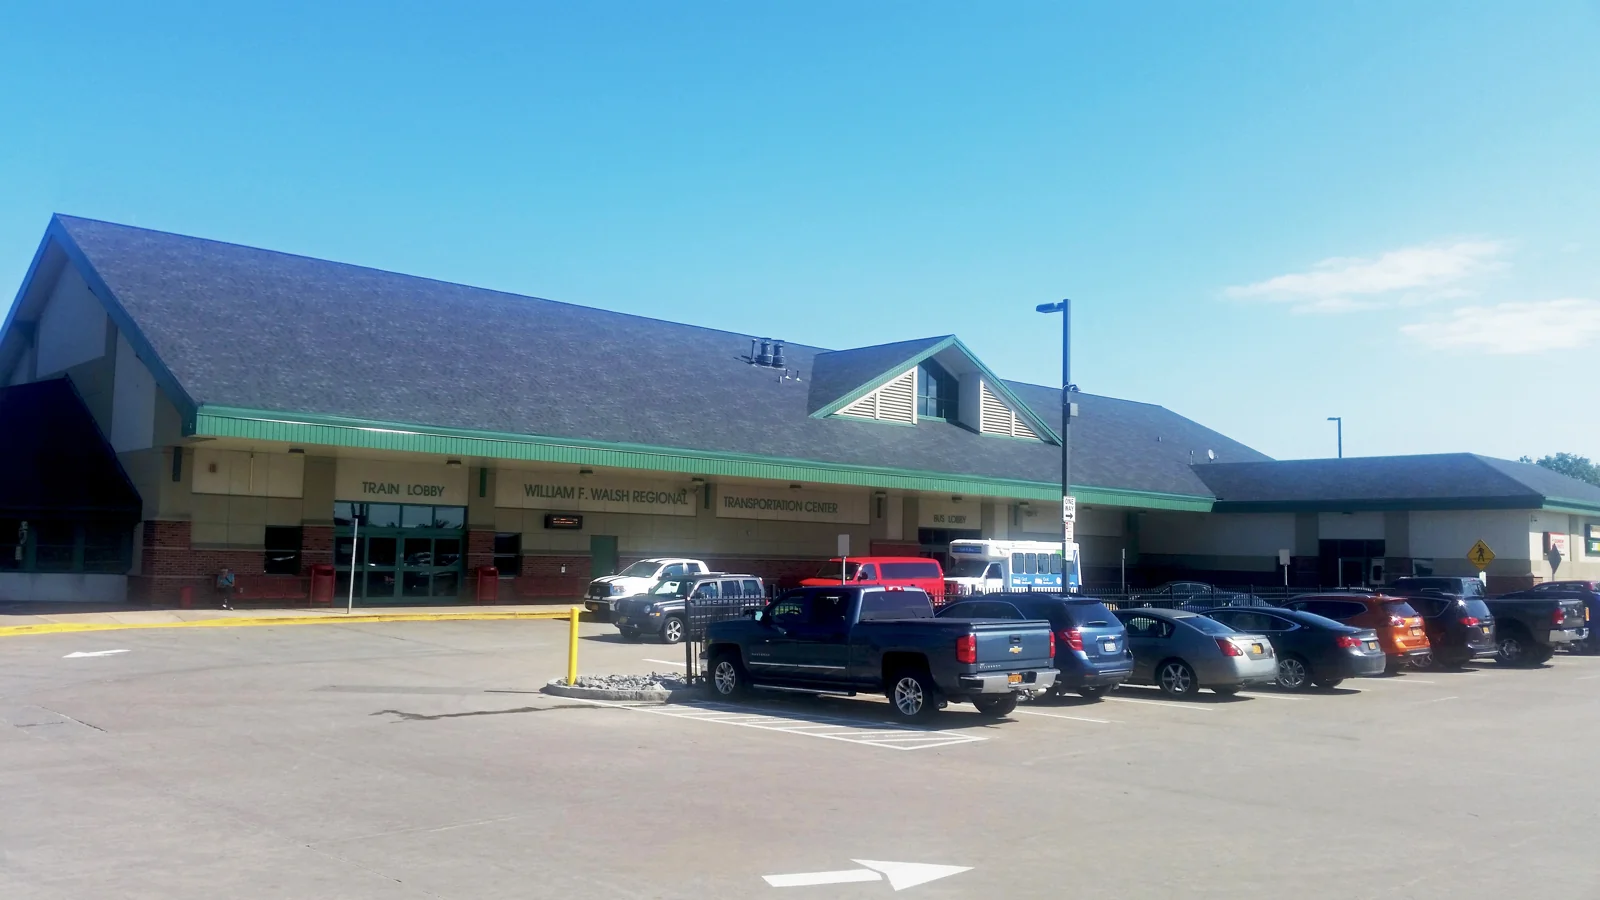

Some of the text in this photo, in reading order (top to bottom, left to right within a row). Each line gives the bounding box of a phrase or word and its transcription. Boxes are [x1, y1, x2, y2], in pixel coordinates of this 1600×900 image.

[362, 481, 445, 497] TRAIN LOBBY
[524, 483, 689, 505] WILLIAM F. WALSH REGIONAL
[724, 496, 838, 513] TRANSPORTATION CENTER
[933, 514, 967, 524] BUS LOBBY
